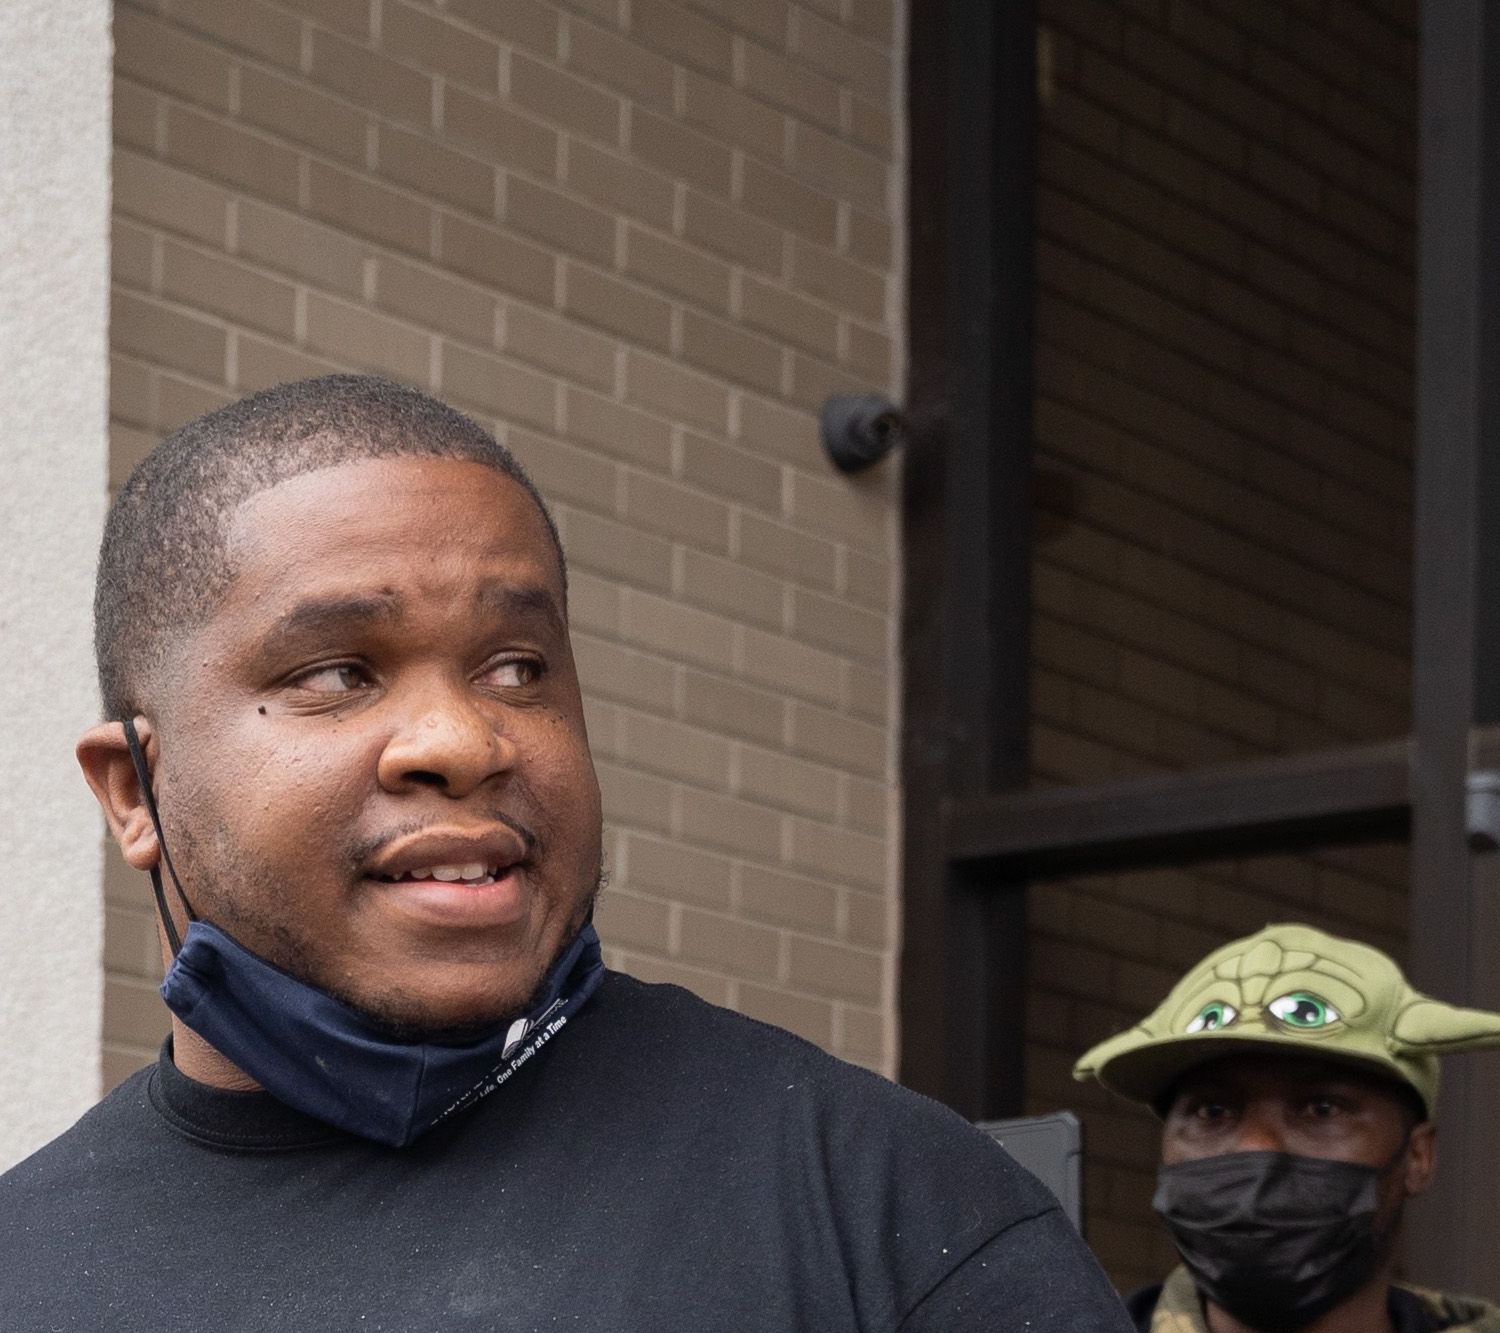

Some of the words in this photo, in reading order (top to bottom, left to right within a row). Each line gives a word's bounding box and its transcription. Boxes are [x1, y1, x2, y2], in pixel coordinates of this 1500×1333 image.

[496, 1069, 513, 1084] One
[510, 1044, 536, 1071] Family
[534, 1035, 545, 1049] at
[546, 1015, 568, 1035] Time
